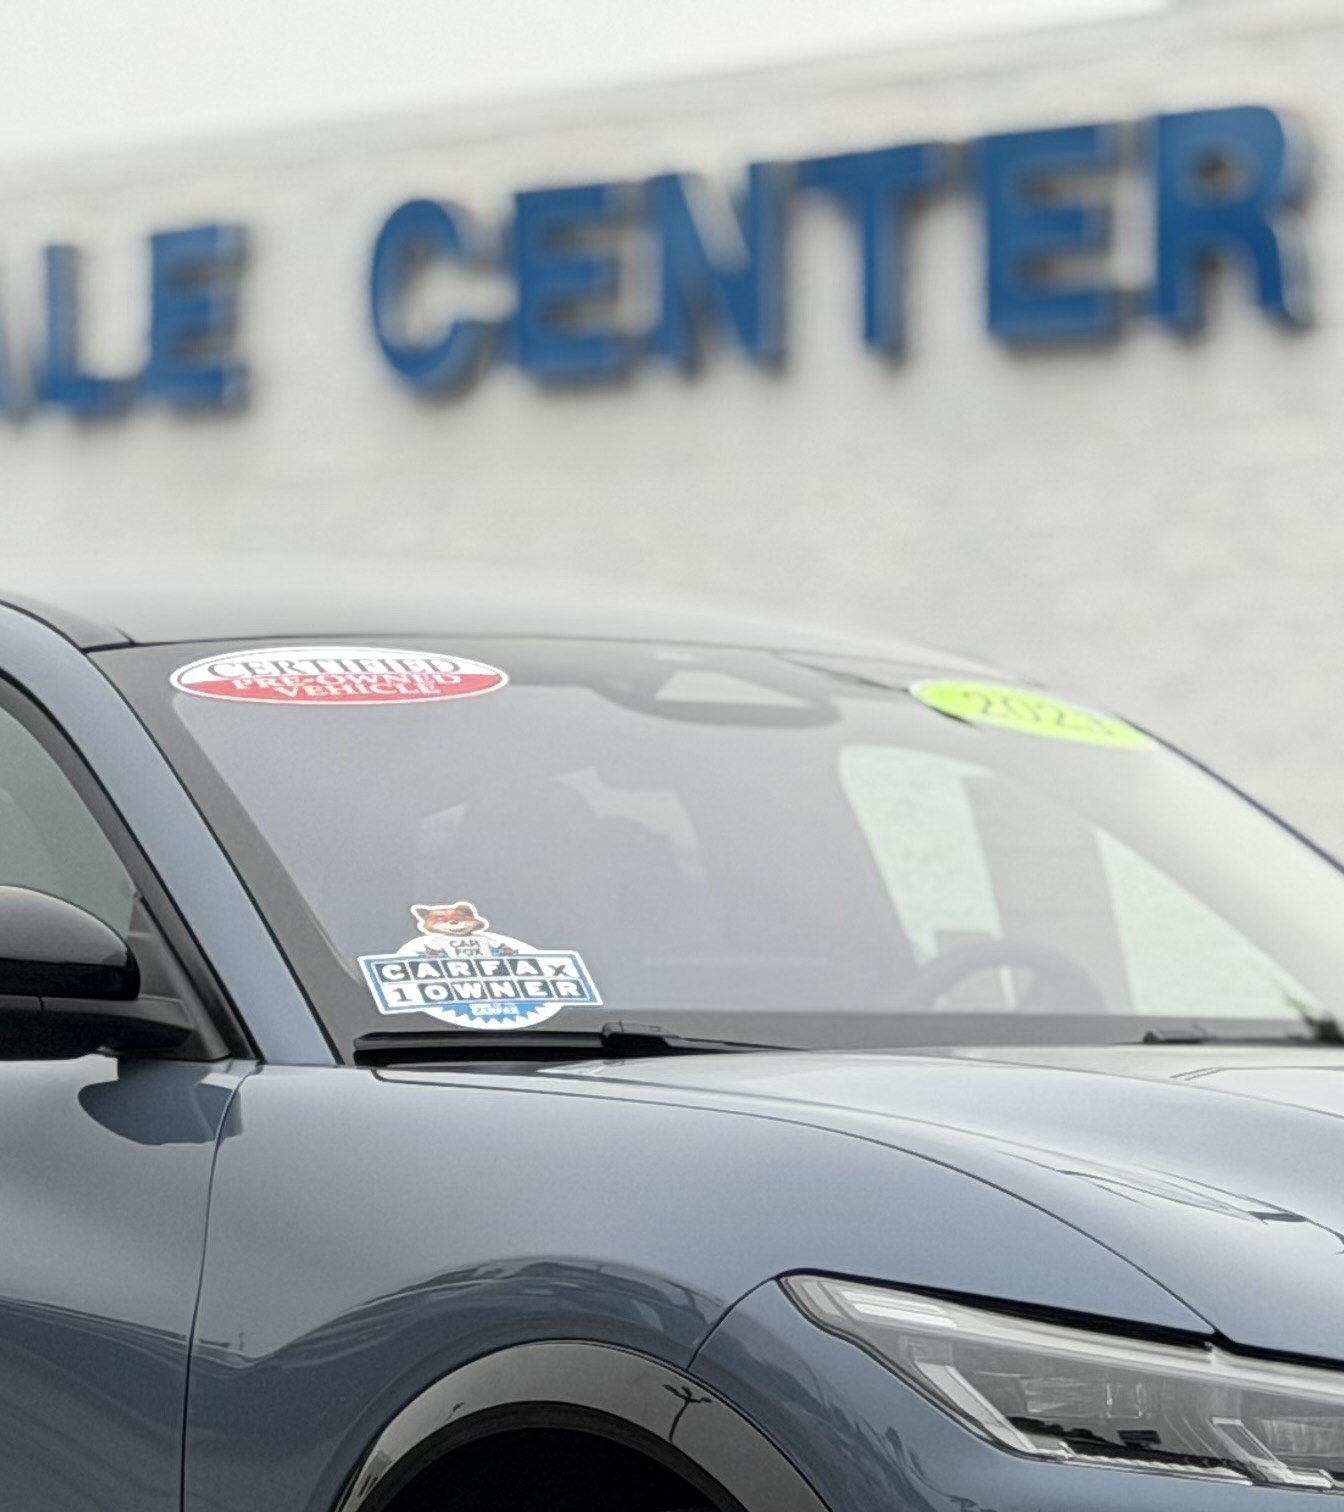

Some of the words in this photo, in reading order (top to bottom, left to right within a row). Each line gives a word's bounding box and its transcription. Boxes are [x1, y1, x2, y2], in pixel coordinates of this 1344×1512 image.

[370, 105, 1315, 402] CENTER
[207, 658, 460, 677] CERTIFIED
[232, 672, 462, 690] PRE-OWNED
[275, 682, 442, 699] VEHICLE
[449, 938, 480, 949] CAR
[381, 960, 576, 981] CARFAX
[392, 986, 413, 1002] 1
[424, 981, 580, 1001] OWNER
